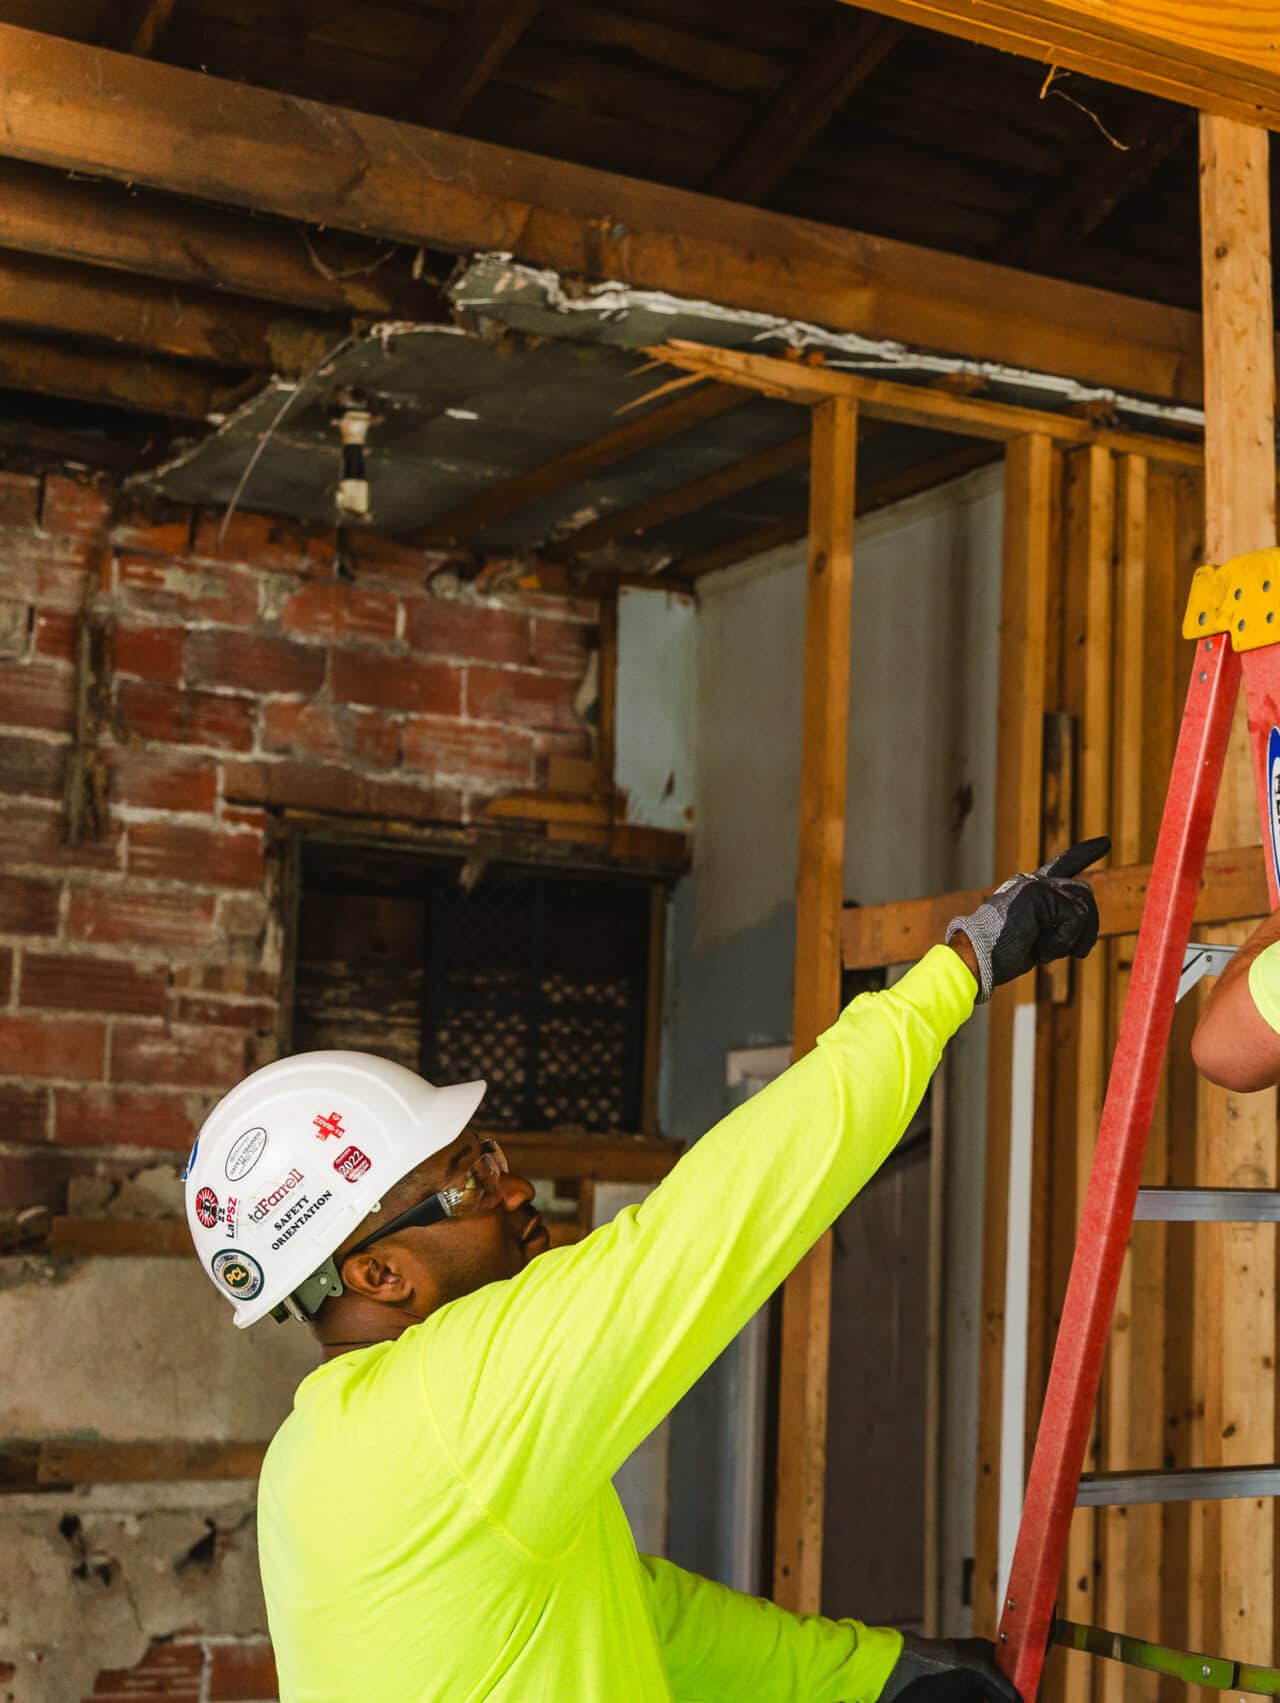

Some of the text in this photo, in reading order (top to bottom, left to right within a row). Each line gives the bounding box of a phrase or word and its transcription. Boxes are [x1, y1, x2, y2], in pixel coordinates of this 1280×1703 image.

[339, 1151, 364, 1175] 2022
[272, 1190, 333, 1251] ORIENTATION
[274, 1195, 309, 1231] SAFETY
[226, 1267, 246, 1285] PCL
